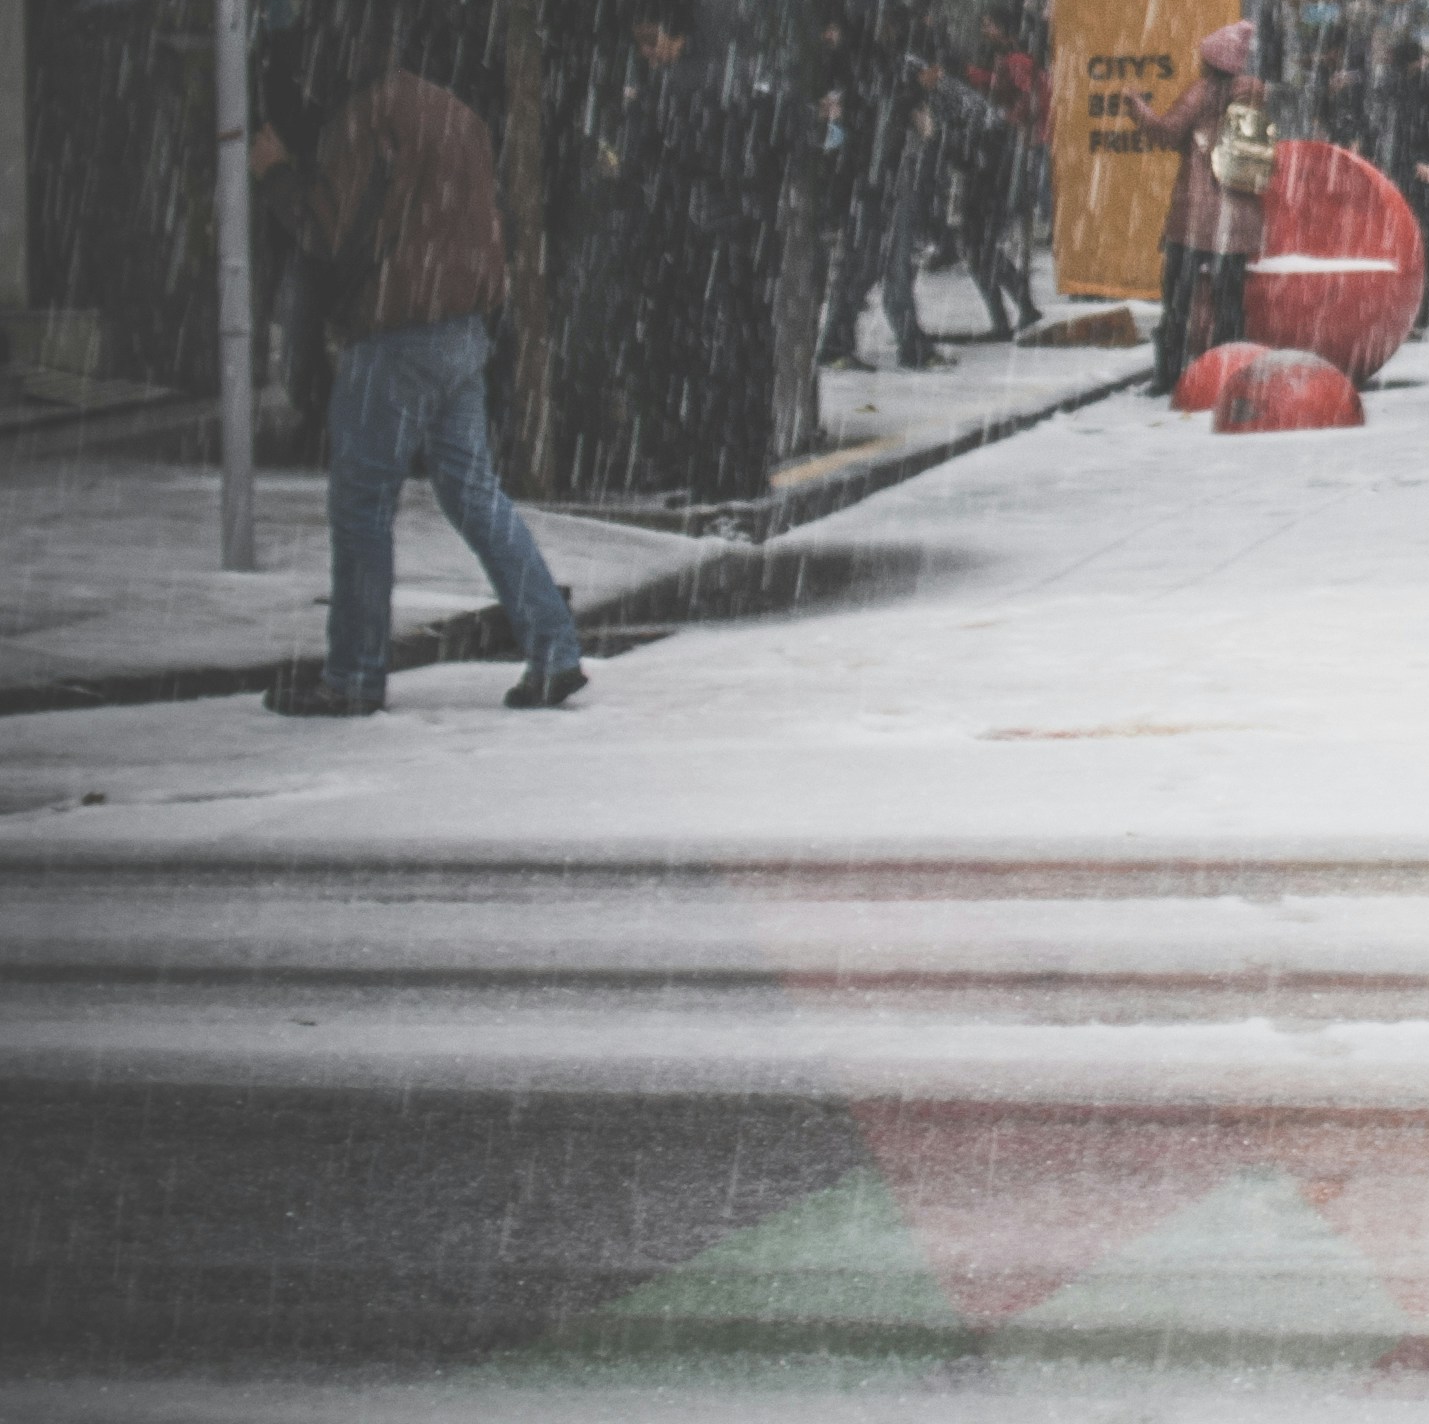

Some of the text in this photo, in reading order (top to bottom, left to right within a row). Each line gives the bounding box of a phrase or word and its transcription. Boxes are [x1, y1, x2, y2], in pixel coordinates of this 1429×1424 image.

[1088, 54, 1174, 79] CITY'S
[1088, 92, 1153, 118] BE
[1089, 129, 1181, 153] FRIE
